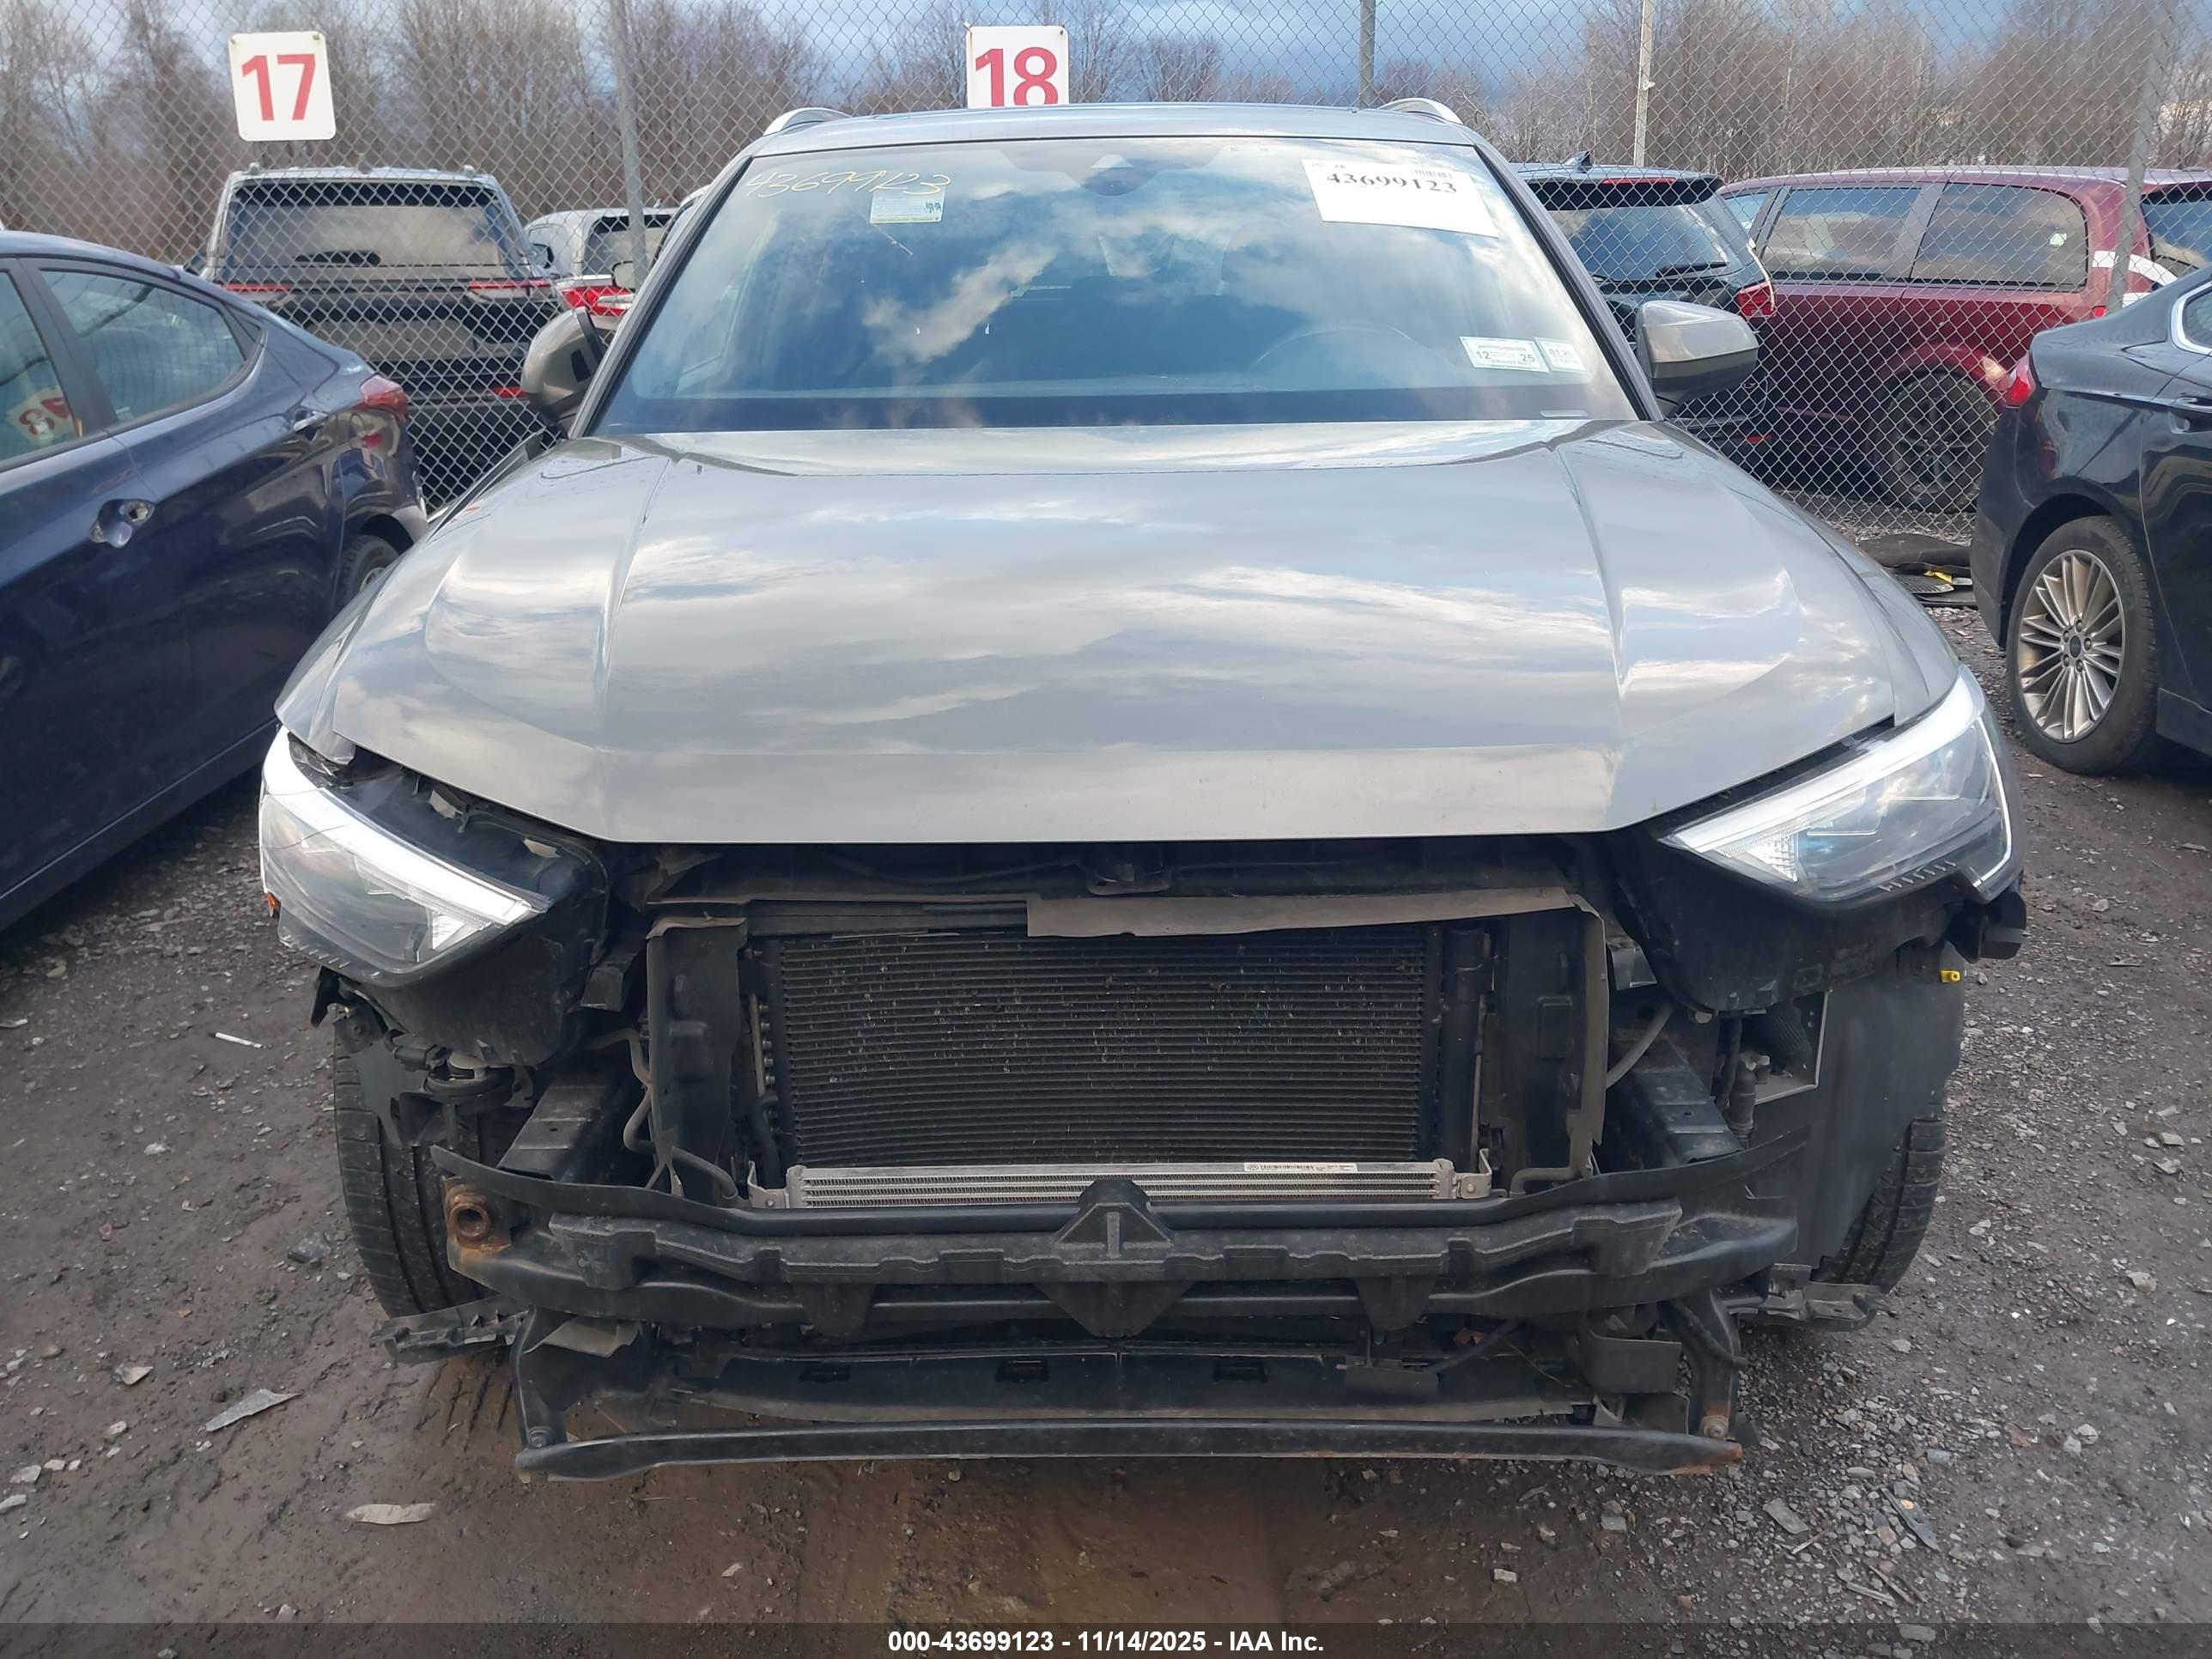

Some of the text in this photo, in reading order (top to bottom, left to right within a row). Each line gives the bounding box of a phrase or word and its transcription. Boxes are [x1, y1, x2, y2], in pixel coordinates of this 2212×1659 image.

[241, 53, 317, 121] 17
[975, 46, 1059, 106] 18
[1326, 172, 1458, 195] 43699123
[1475, 350, 1492, 360] 12
[1519, 353, 1536, 363] 25
